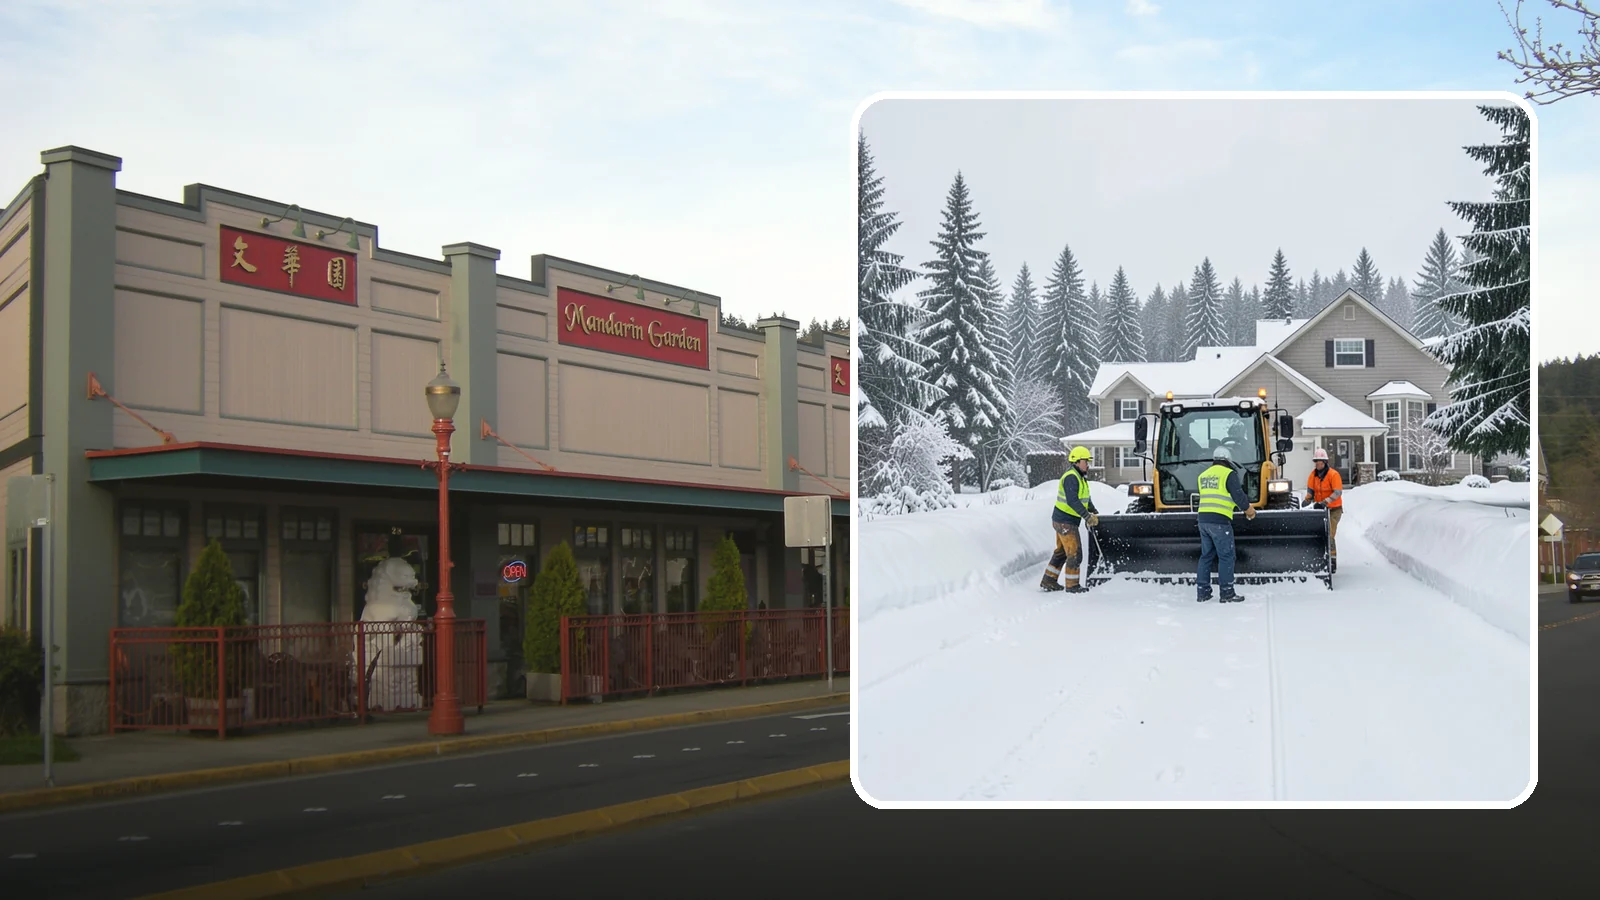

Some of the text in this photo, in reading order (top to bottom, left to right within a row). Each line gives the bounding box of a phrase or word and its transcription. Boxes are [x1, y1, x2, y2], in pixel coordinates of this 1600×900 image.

[231, 235, 346, 291] 文華園
[565, 302, 701, 352] Mandarin Garden
[503, 565, 527, 578] OPEN
